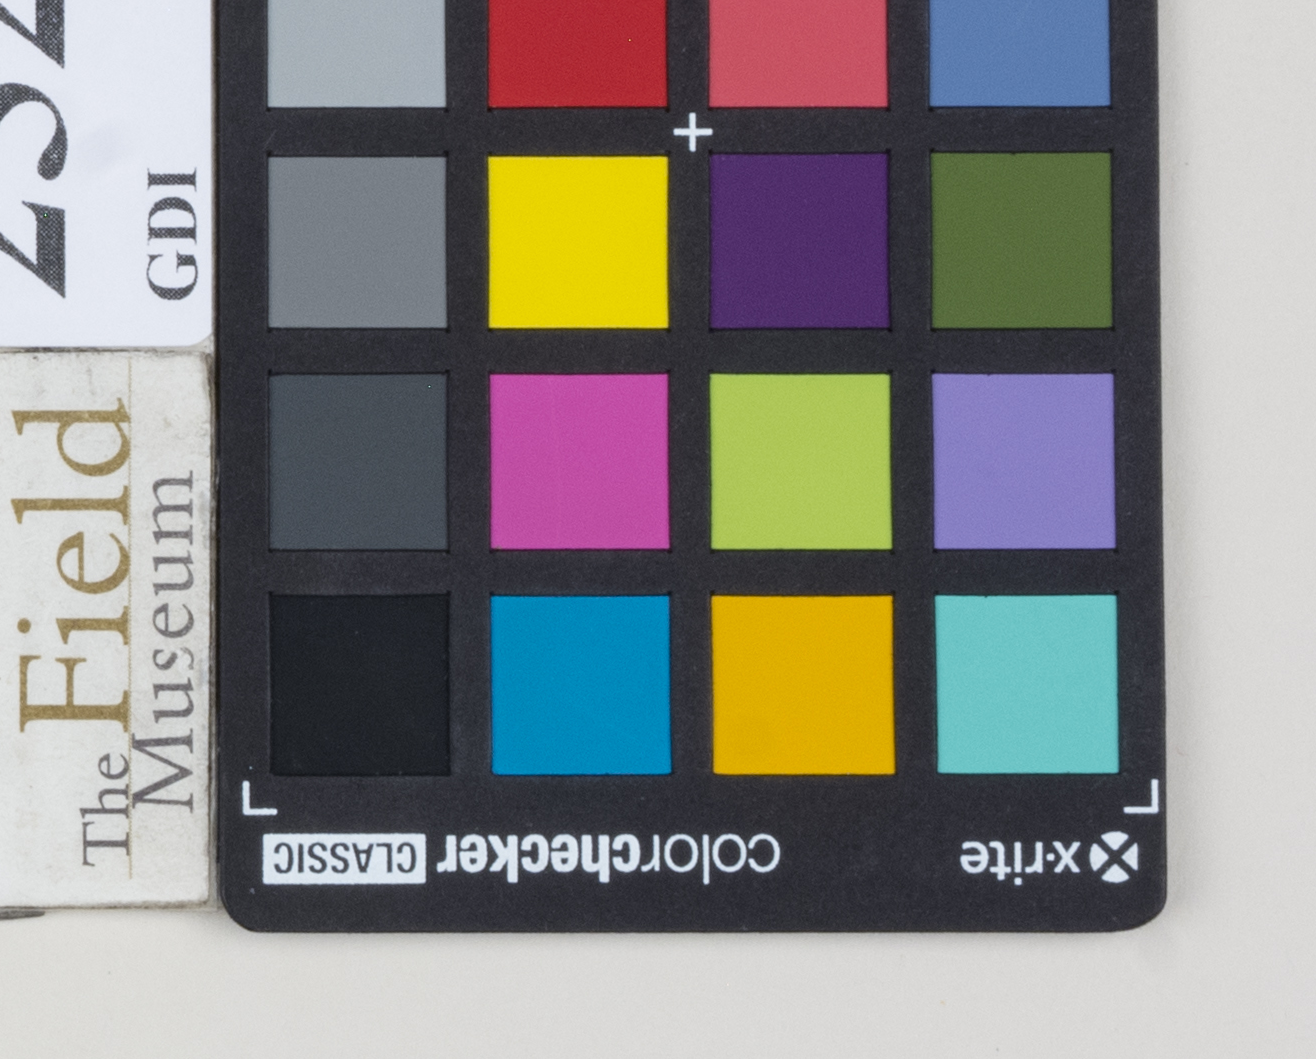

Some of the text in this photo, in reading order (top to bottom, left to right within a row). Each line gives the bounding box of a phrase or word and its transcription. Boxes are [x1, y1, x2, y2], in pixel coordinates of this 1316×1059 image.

[147, 169, 199, 301] GDI
[11, 397, 132, 867] The Field
[130, 469, 195, 814] Museum
[273, 832, 781, 885] colorchecker CLASSIC
